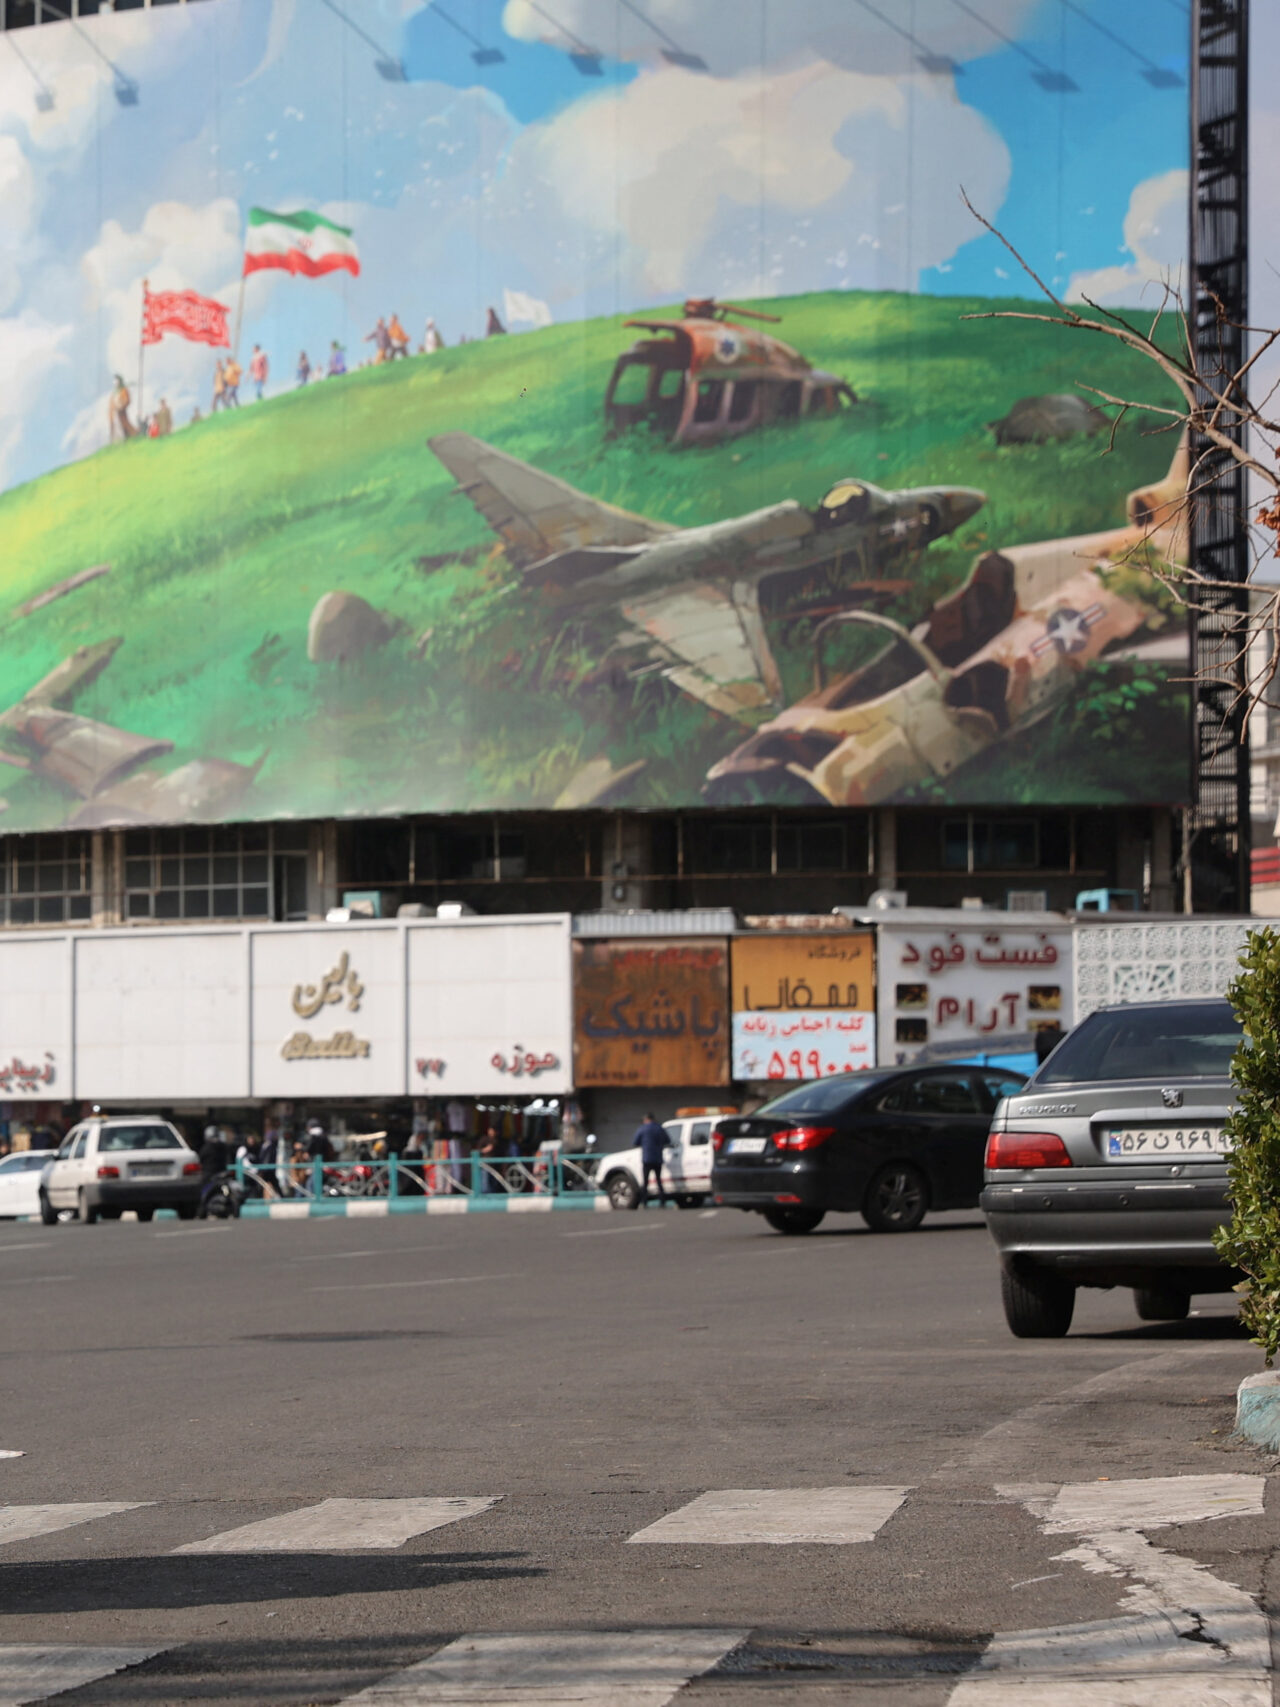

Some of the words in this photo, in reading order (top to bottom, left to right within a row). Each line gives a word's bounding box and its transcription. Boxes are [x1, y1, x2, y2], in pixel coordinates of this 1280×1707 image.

[901, 932, 965, 974] فود
[976, 932, 1058, 965] فست
[293, 951, 364, 1019] بالین
[835, 1016, 864, 1031] کلیه
[937, 992, 1020, 1032] آرام
[742, 1017, 777, 1037] زنانه
[781, 1017, 831, 1036] اجناس
[1123, 1132, 1147, 1149] ۵۶
[1175, 1130, 1212, 1149] ۹۶۹
